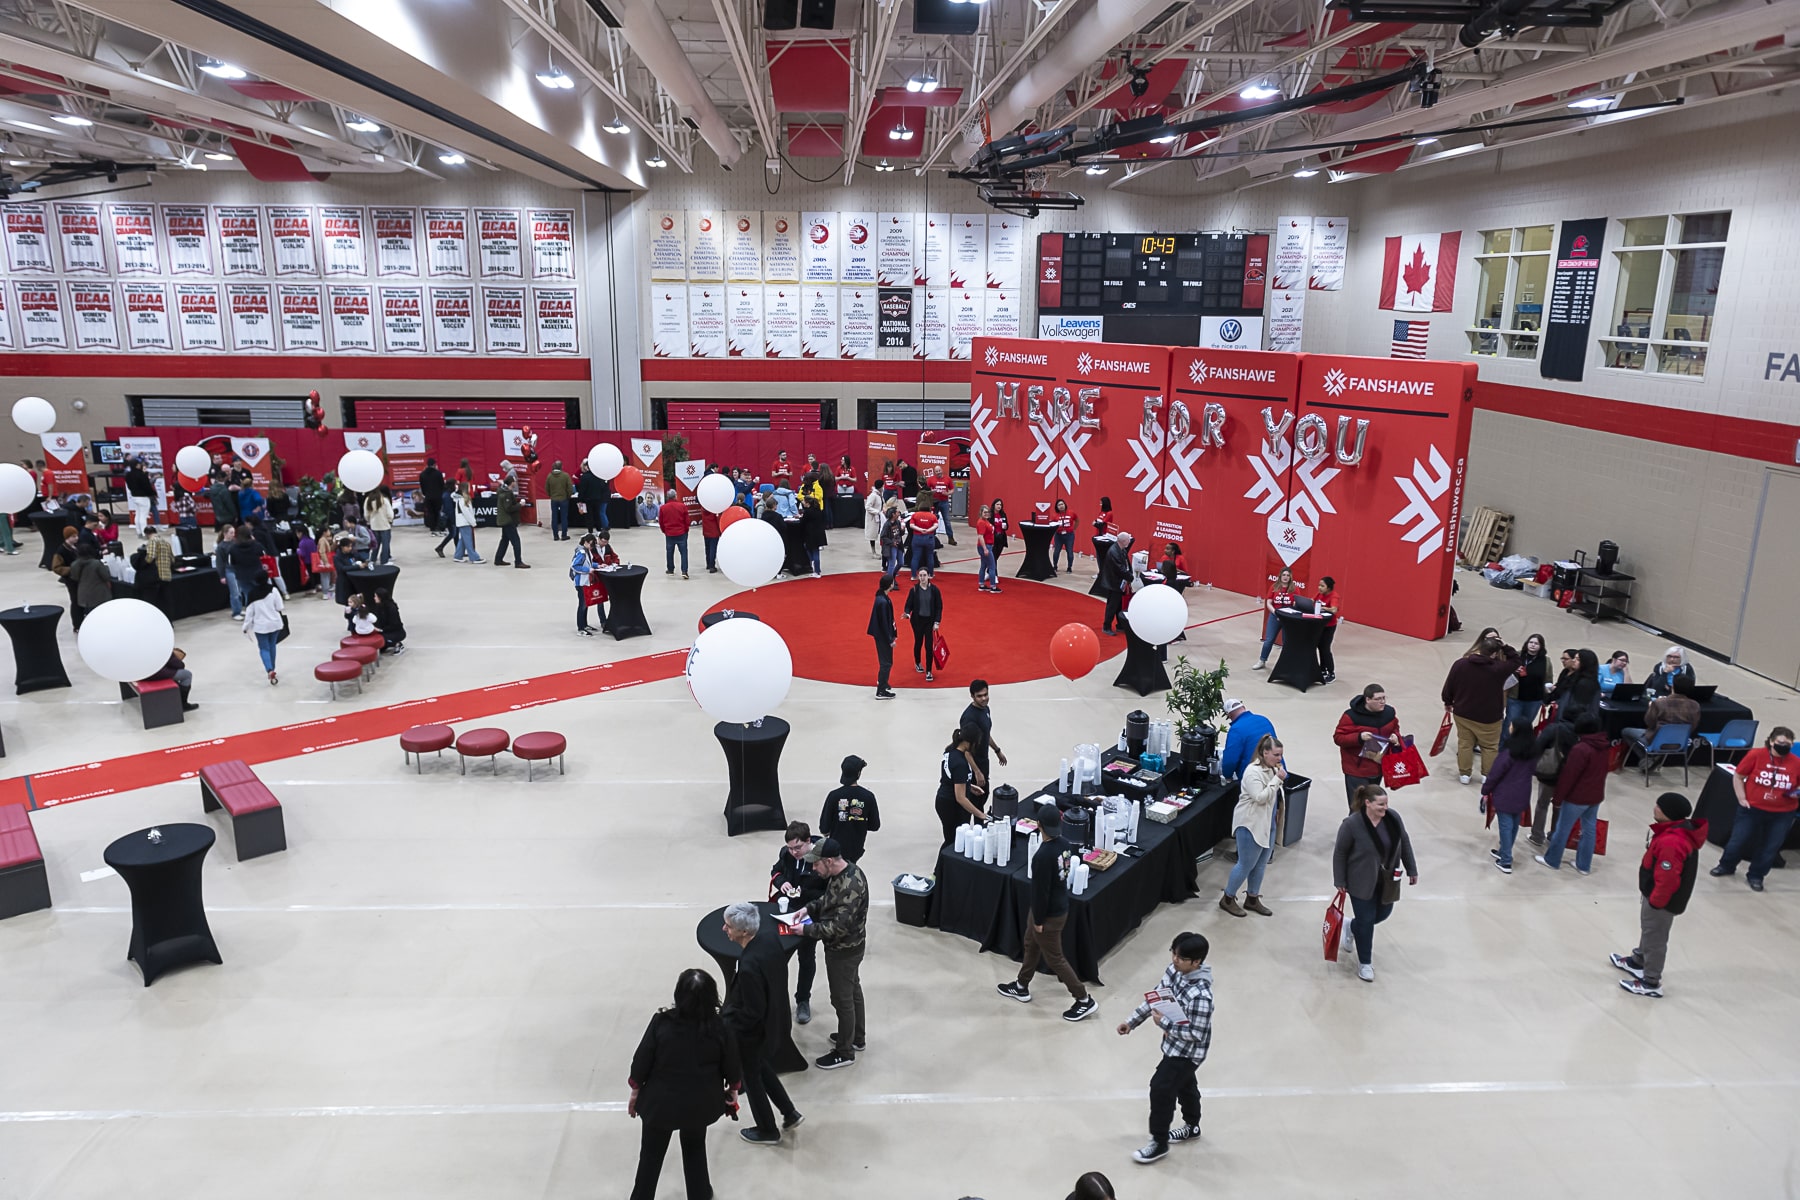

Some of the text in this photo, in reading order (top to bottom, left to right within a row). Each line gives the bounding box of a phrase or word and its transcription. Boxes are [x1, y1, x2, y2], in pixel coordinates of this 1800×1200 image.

[7, 214, 43, 225] OCAA
[62, 215, 97, 226] OCAA
[116, 216, 151, 226] OCAA
[169, 218, 204, 228] OCAA
[222, 218, 256, 228] OCAA
[274, 218, 309, 229] OCAA
[325, 219, 359, 229] OCAA
[377, 220, 411, 230] OCAA
[429, 221, 463, 231] OCAA
[482, 221, 516, 231] OCAA
[535, 222, 569, 232] OCAA
[429, 232, 464, 240] CHAMPIONS
[482, 232, 517, 240] CHAMPIONS
[534, 233, 570, 241] CHAMPIONS
[1141, 237, 1175, 254] 10:43
[22, 292, 56, 303] OCAA
[75, 293, 110, 303] OCAA
[128, 293, 163, 303] OCAA
[182, 295, 215, 305] OCAA
[233, 295, 267, 305] OCAA
[284, 296, 318, 306] OCAA
[334, 297, 368, 306] OCAA
[386, 299, 418, 309] OCAA
[436, 299, 468, 309] OCAA
[488, 299, 520, 309] OCAA
[540, 300, 572, 310] OCAA
[488, 310, 522, 318] CHAMPIONS
[1060, 318, 1101, 328] Leavens
[1042, 324, 1100, 340] Volkswagen
[886, 337, 904, 346] 2016
[999, 352, 1048, 365] FANSHAWE
[1094, 359, 1150, 374] FANSHAWE
[1209, 366, 1276, 382] FANSHAWE
[1349, 377, 1435, 396] FANSHAWE
[995, 381, 1371, 467] HERE FOR YOU
[1446, 458, 1464, 553] fanshawec.ca
[1156, 521, 1183, 529] TRANSITION
[1160, 527, 1182, 535] LEARNING
[1153, 532, 1184, 542] ADVISORS
[1277, 542, 1301, 551] FANSHAWE
[165, 742, 211, 754] FANSHAWE
[316, 738, 359, 750] FANSHAWE
[34, 766, 86, 778] FANSHAWE
[1760, 771, 1790, 782] OPEN
[61, 788, 115, 802] FANSHAWE
